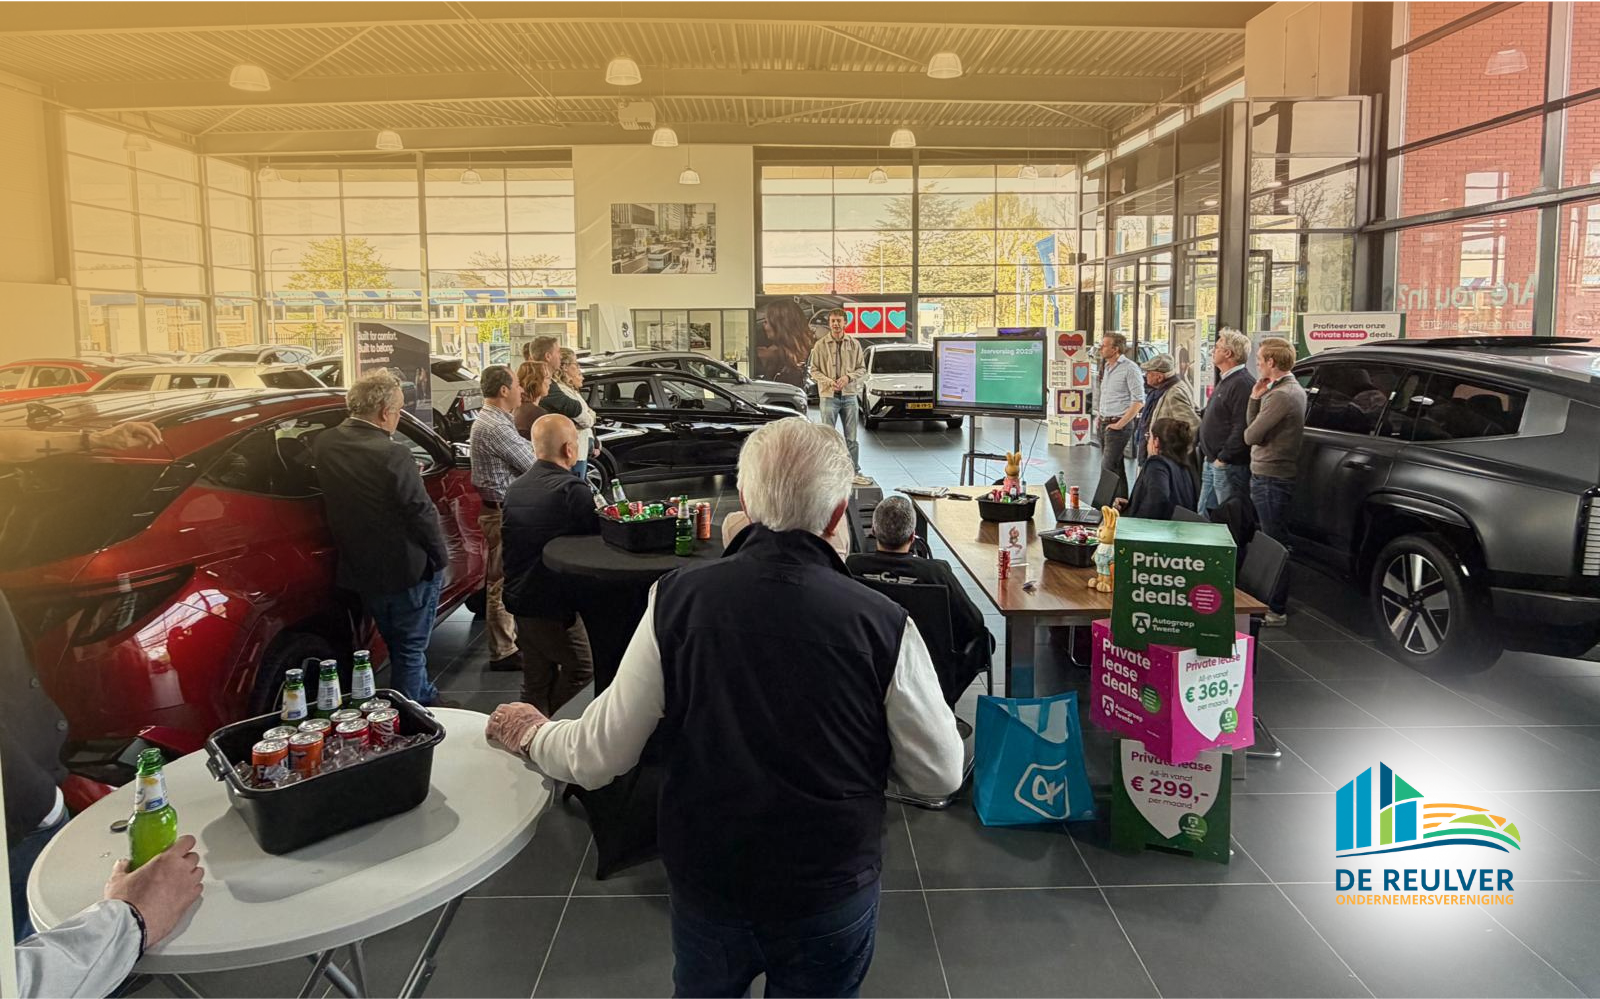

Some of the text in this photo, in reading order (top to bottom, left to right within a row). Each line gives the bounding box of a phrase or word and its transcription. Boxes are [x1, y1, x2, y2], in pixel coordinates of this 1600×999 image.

[357, 330, 369, 341] Built
[369, 330, 377, 341] for
[357, 342, 370, 353] Built
[370, 344, 376, 353] to
[1132, 551, 1206, 572] Private
[1132, 568, 1187, 588] lease
[1131, 586, 1193, 607] deals.
[1152, 617, 1195, 629] Autogroep
[1152, 624, 1181, 634] Twente
[1102, 637, 1151, 670] Private
[1102, 653, 1138, 682] lease
[1185, 657, 1217, 672] Private
[1101, 672, 1143, 703] deals.
[1185, 679, 1239, 703] € 369,-
[1178, 760, 1212, 772] ease
[1170, 773, 1193, 782] vanaf
[1130, 775, 1209, 804] € 299,-
[1162, 799, 1193, 809] maand
